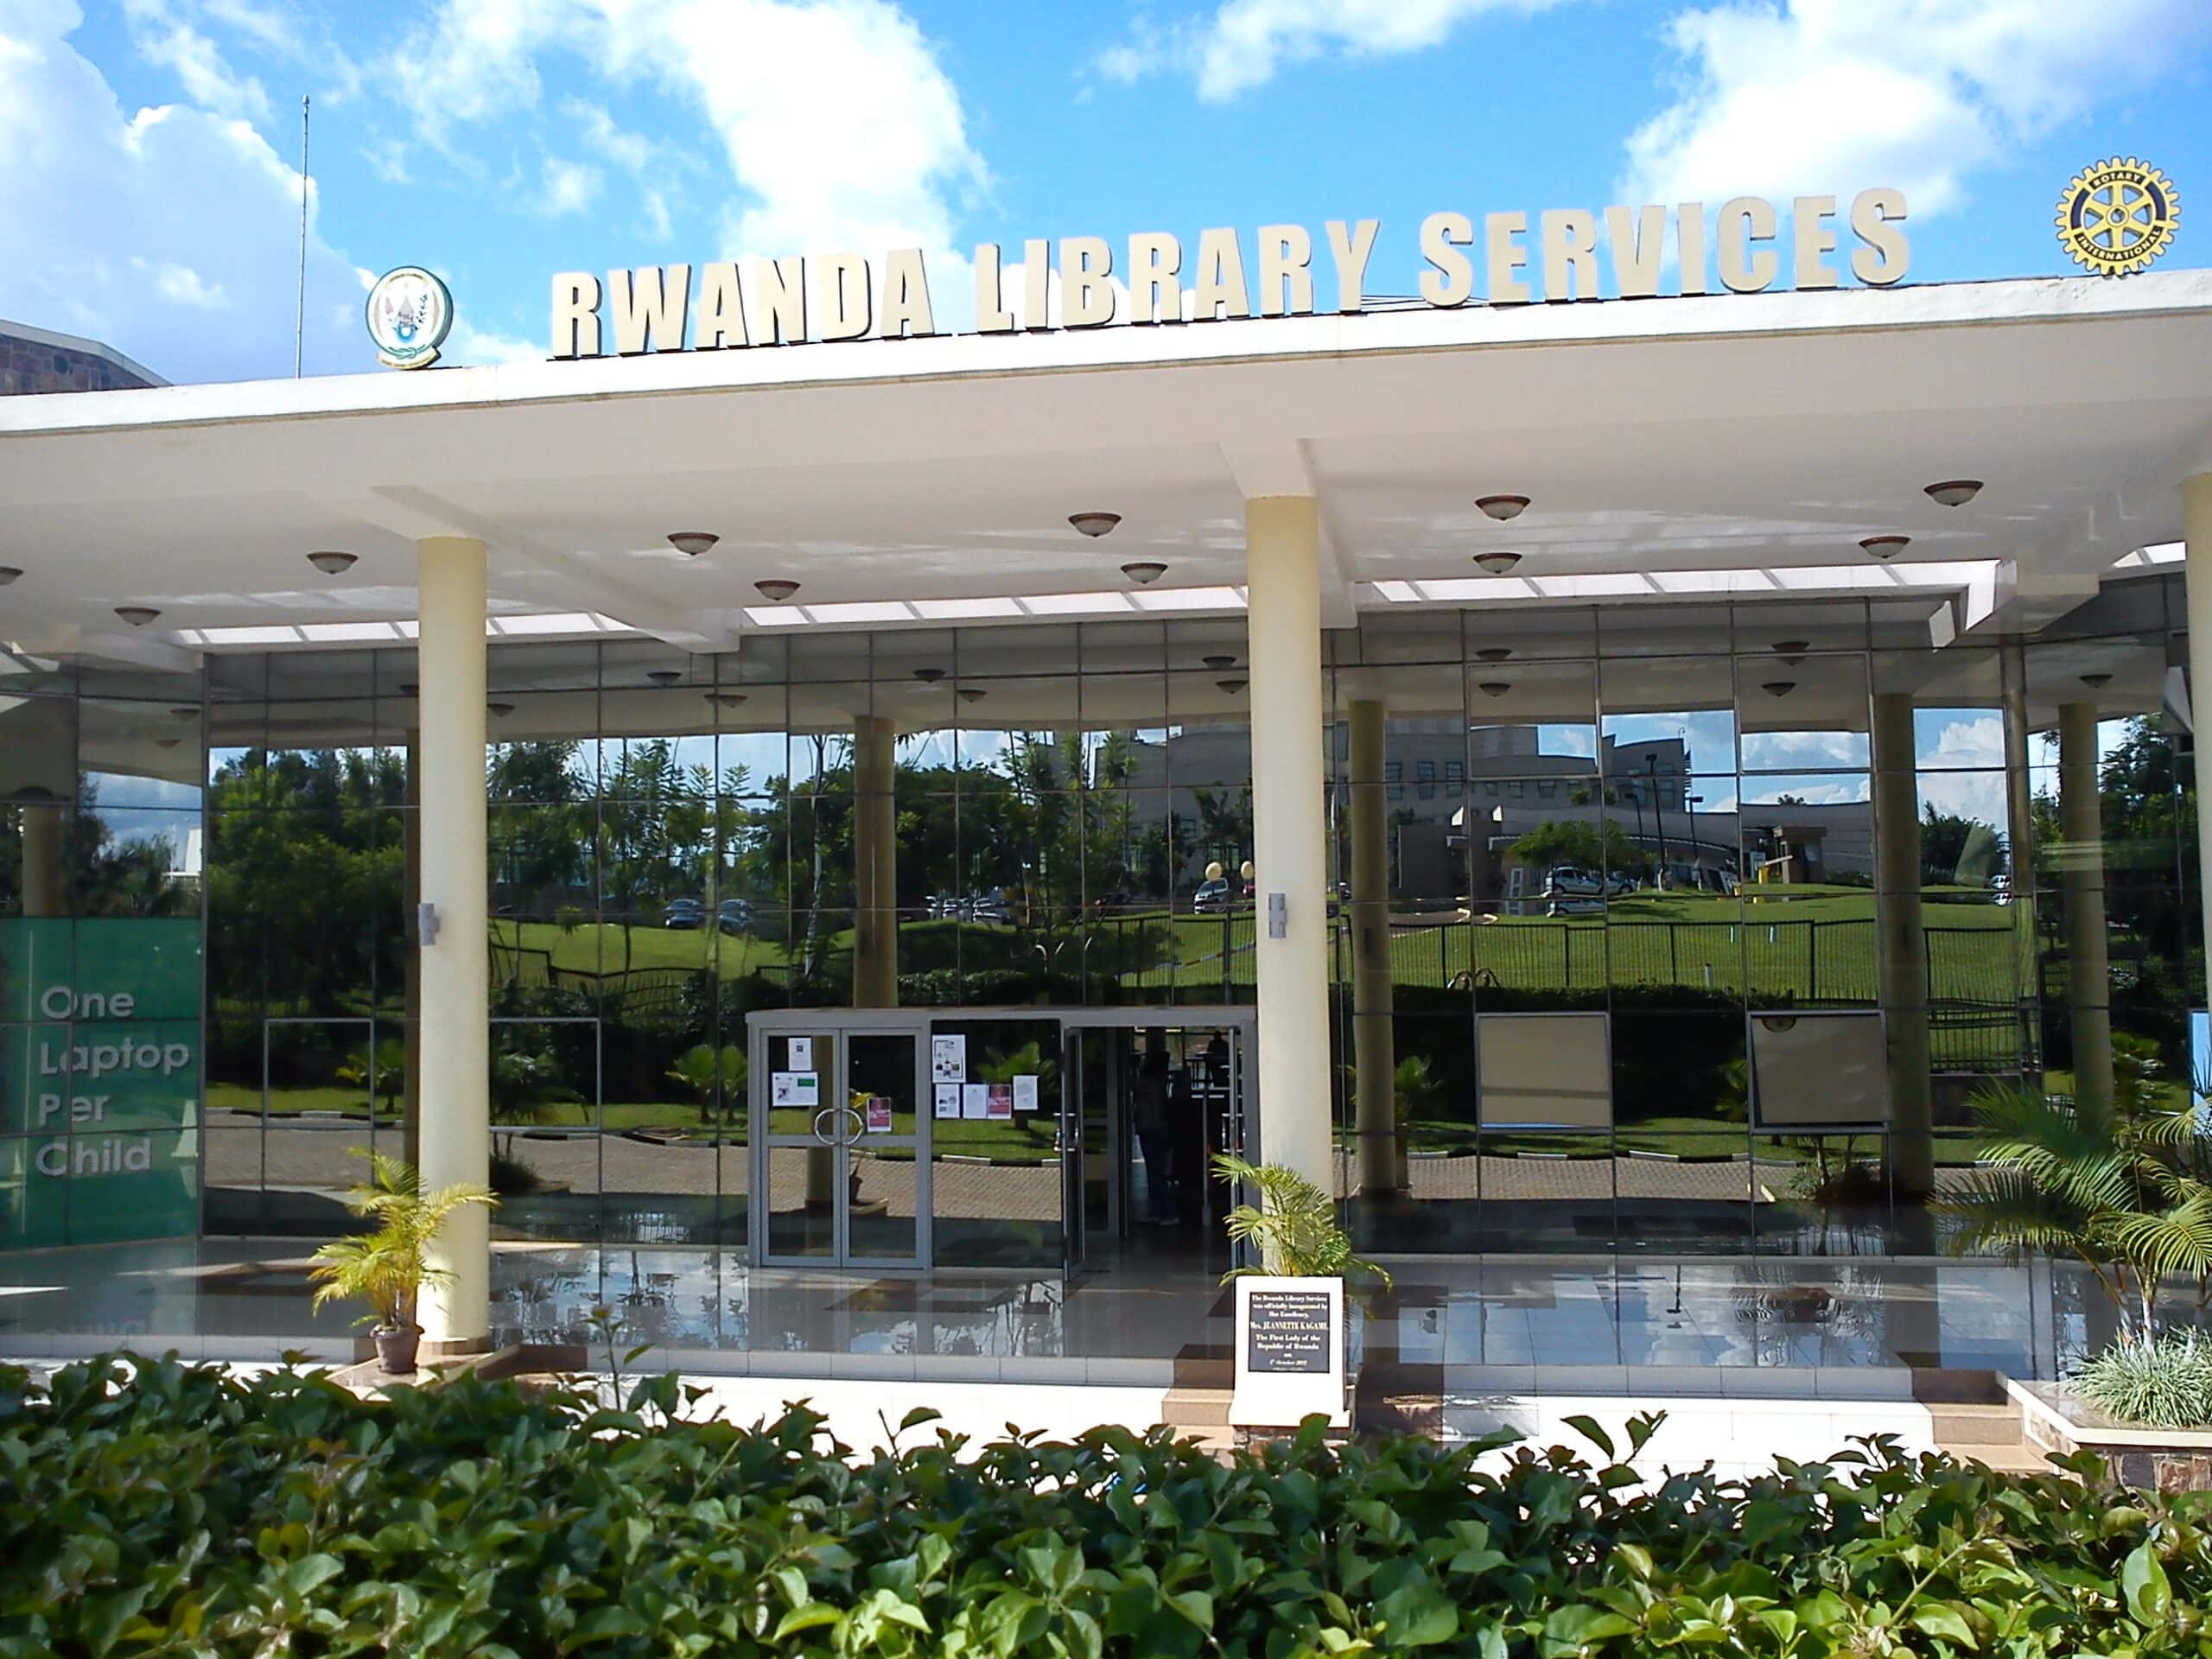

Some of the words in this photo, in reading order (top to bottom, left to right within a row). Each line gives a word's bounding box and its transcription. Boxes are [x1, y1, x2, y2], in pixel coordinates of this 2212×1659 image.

[2077, 228, 2160, 260] INTERNATIONAL
[551, 248, 936, 359] RWANDA
[975, 219, 1381, 333] LIBRARY
[1419, 188, 1910, 308] SERVICES
[41, 986, 135, 1020] One
[40, 1037, 190, 1078] Laptop
[39, 1093, 110, 1127] Per
[35, 1138, 152, 1176] Child
